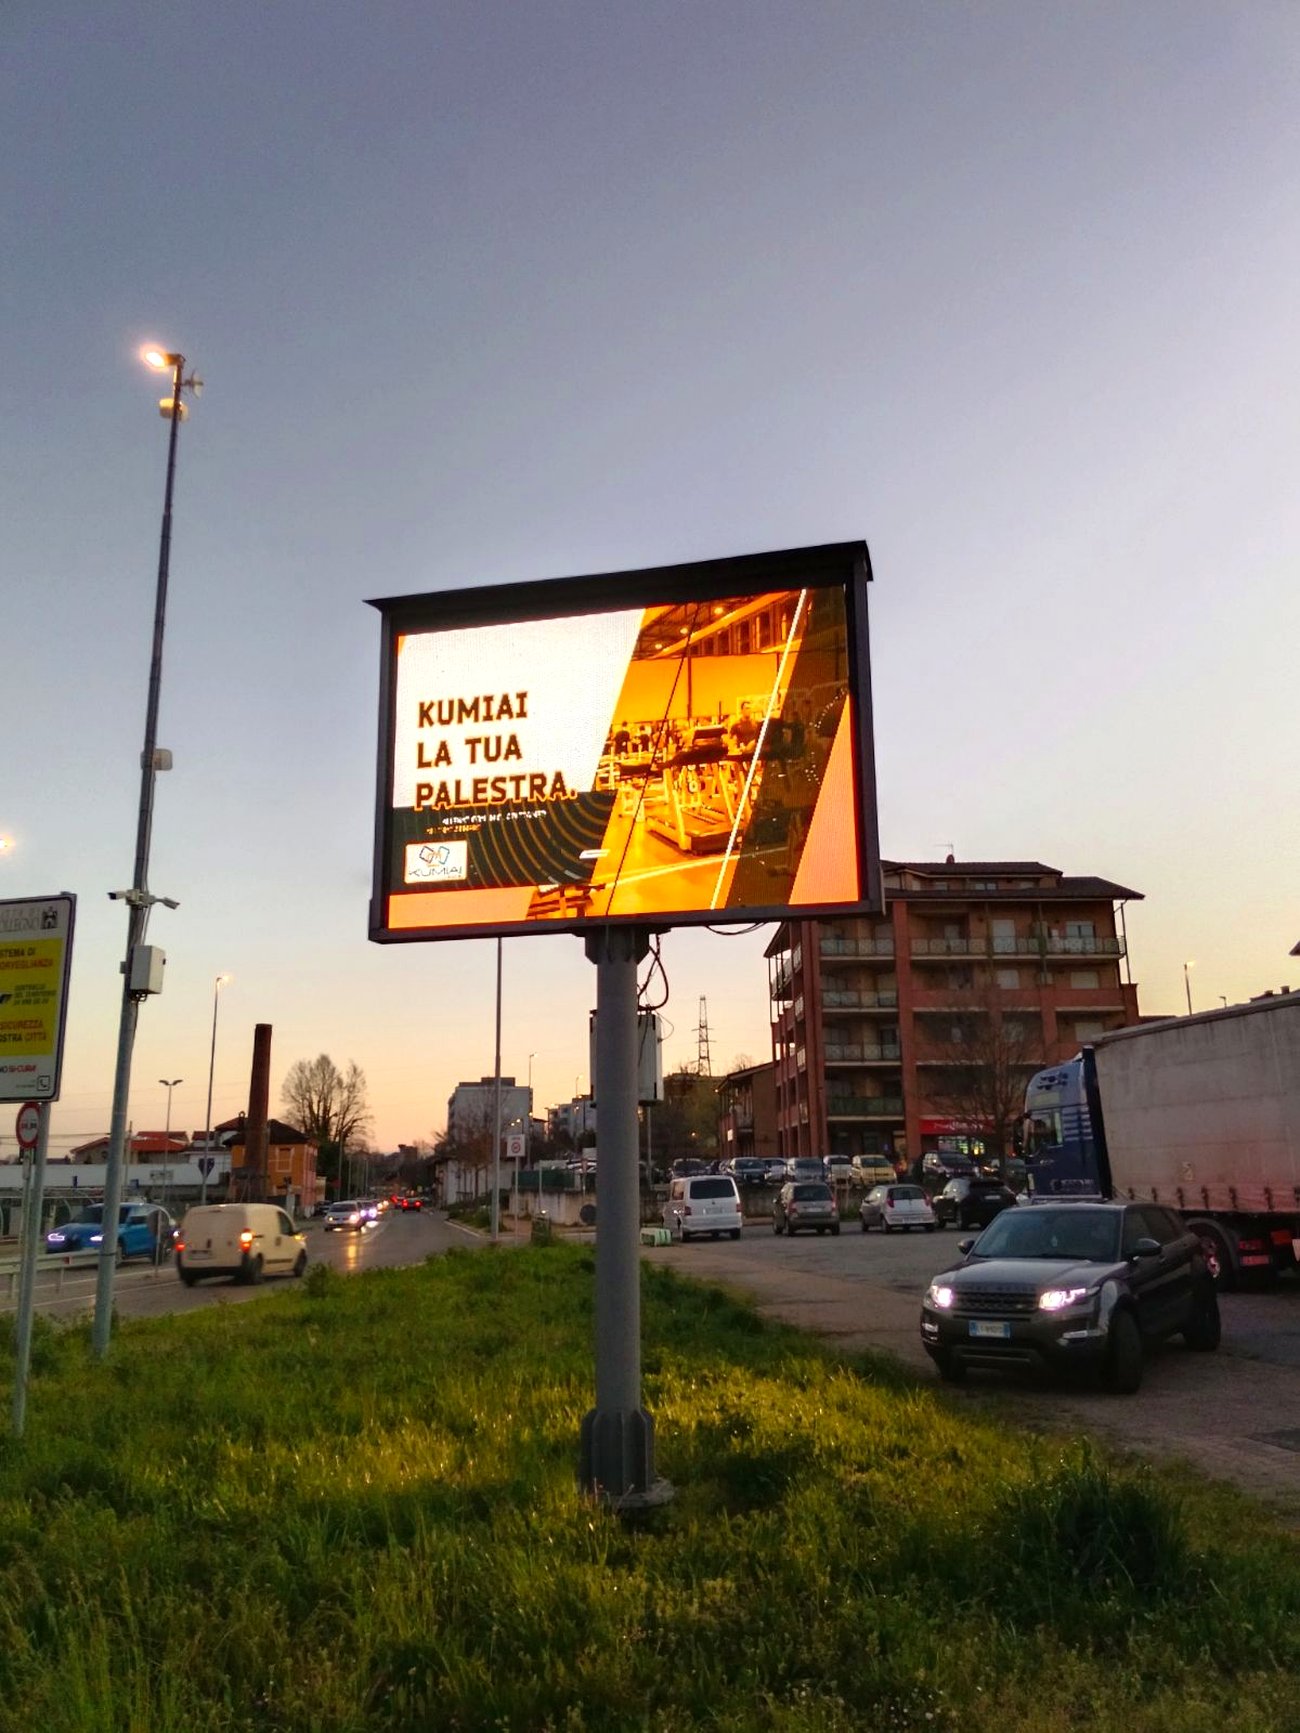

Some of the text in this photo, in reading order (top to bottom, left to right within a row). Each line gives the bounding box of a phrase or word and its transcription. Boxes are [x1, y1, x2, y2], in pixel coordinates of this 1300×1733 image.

[418, 690, 528, 728] KUMIAI
[416, 733, 523, 769] LA TUA
[414, 770, 578, 811] PALESTRA.
